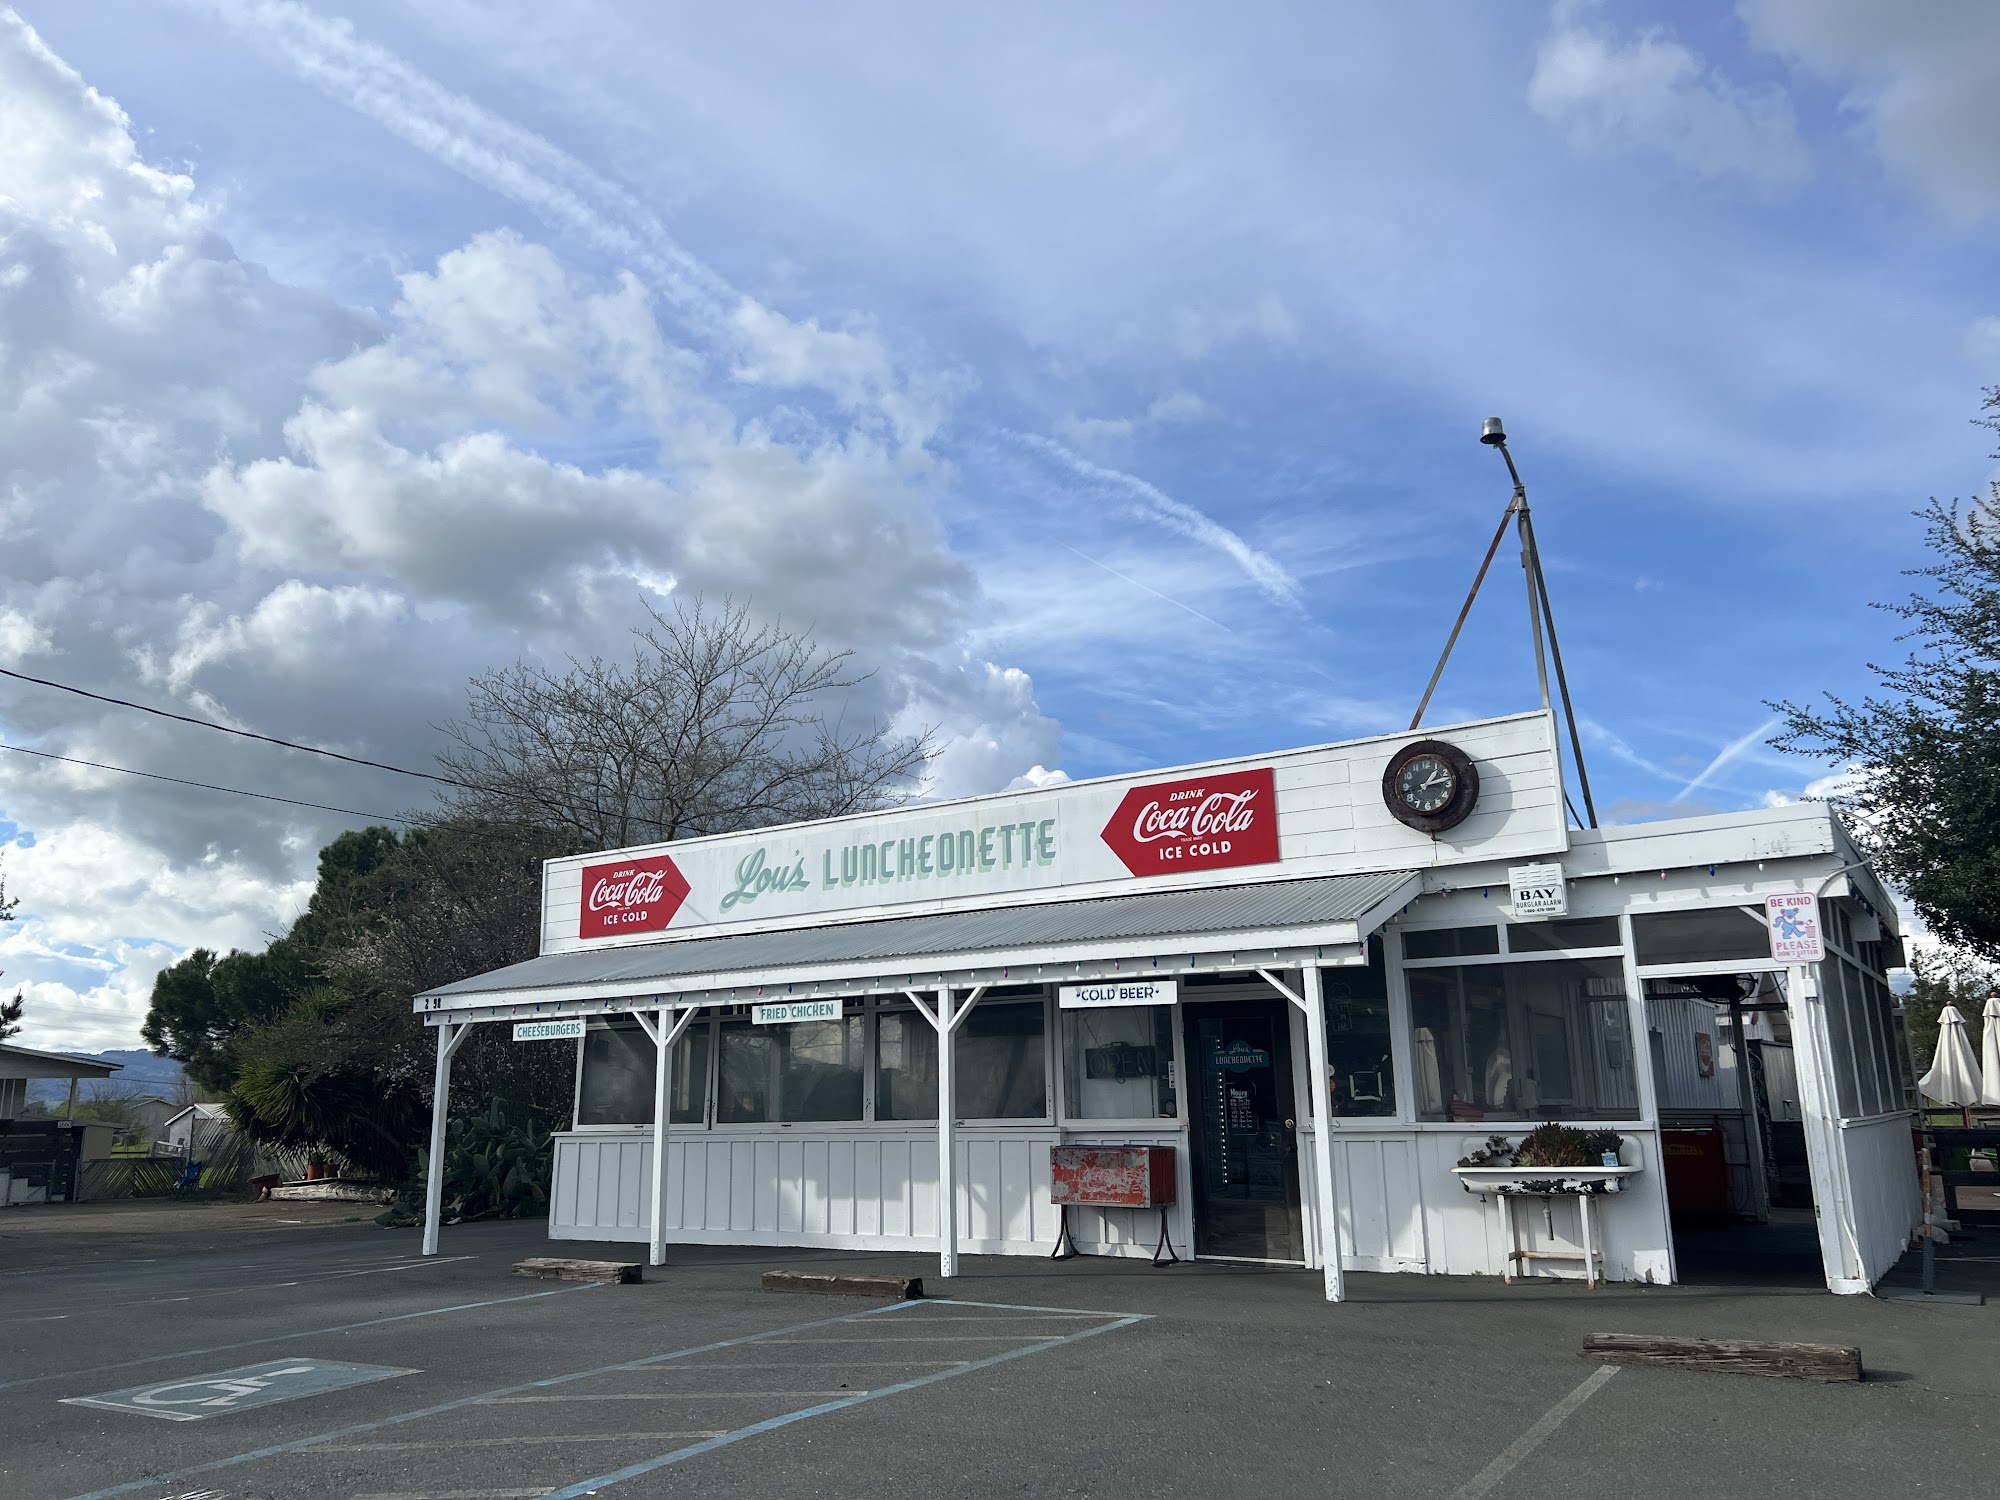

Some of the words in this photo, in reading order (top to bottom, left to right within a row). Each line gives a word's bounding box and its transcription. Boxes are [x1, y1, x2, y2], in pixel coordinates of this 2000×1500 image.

[1413, 764, 1419, 772] 11
[1422, 760, 1431, 769] 12
[1404, 772, 1412, 780] 10
[1443, 769, 1449, 777] 2
[1403, 783, 1410, 791] 9
[1168, 788, 1206, 801] DRINK
[1407, 794, 1414, 802] 8
[1414, 800, 1421, 808] 7
[1424, 801, 1431, 810] 6
[1435, 799, 1442, 808] 5
[1133, 789, 1260, 843] Coca-Cola
[1159, 846, 1183, 860] ICE
[1189, 840, 1231, 857] COLD
[720, 848, 810, 912] Lou's
[823, 819, 1056, 889] LUNCHEONETTE
[612, 869, 636, 879] DRINK
[589, 870, 668, 912] Coca-Cola
[1520, 888, 1556, 901] BAY
[1516, 900, 1541, 908] BURGLAR
[1770, 898, 1783, 907] BE
[1787, 896, 1811, 906] KIND
[603, 914, 618, 926] ICE
[622, 911, 648, 923] COLD
[1776, 940, 1818, 950] PLEASE
[1081, 988, 1115, 1001] COLD
[1120, 986, 1154, 999] BEER
[761, 1007, 787, 1020] FRIED
[791, 1003, 834, 1018] CHICKEN
[517, 1023, 581, 1037] CHEESEBURGERS
[1215, 1055, 1263, 1065] LUNCHEONETTE
